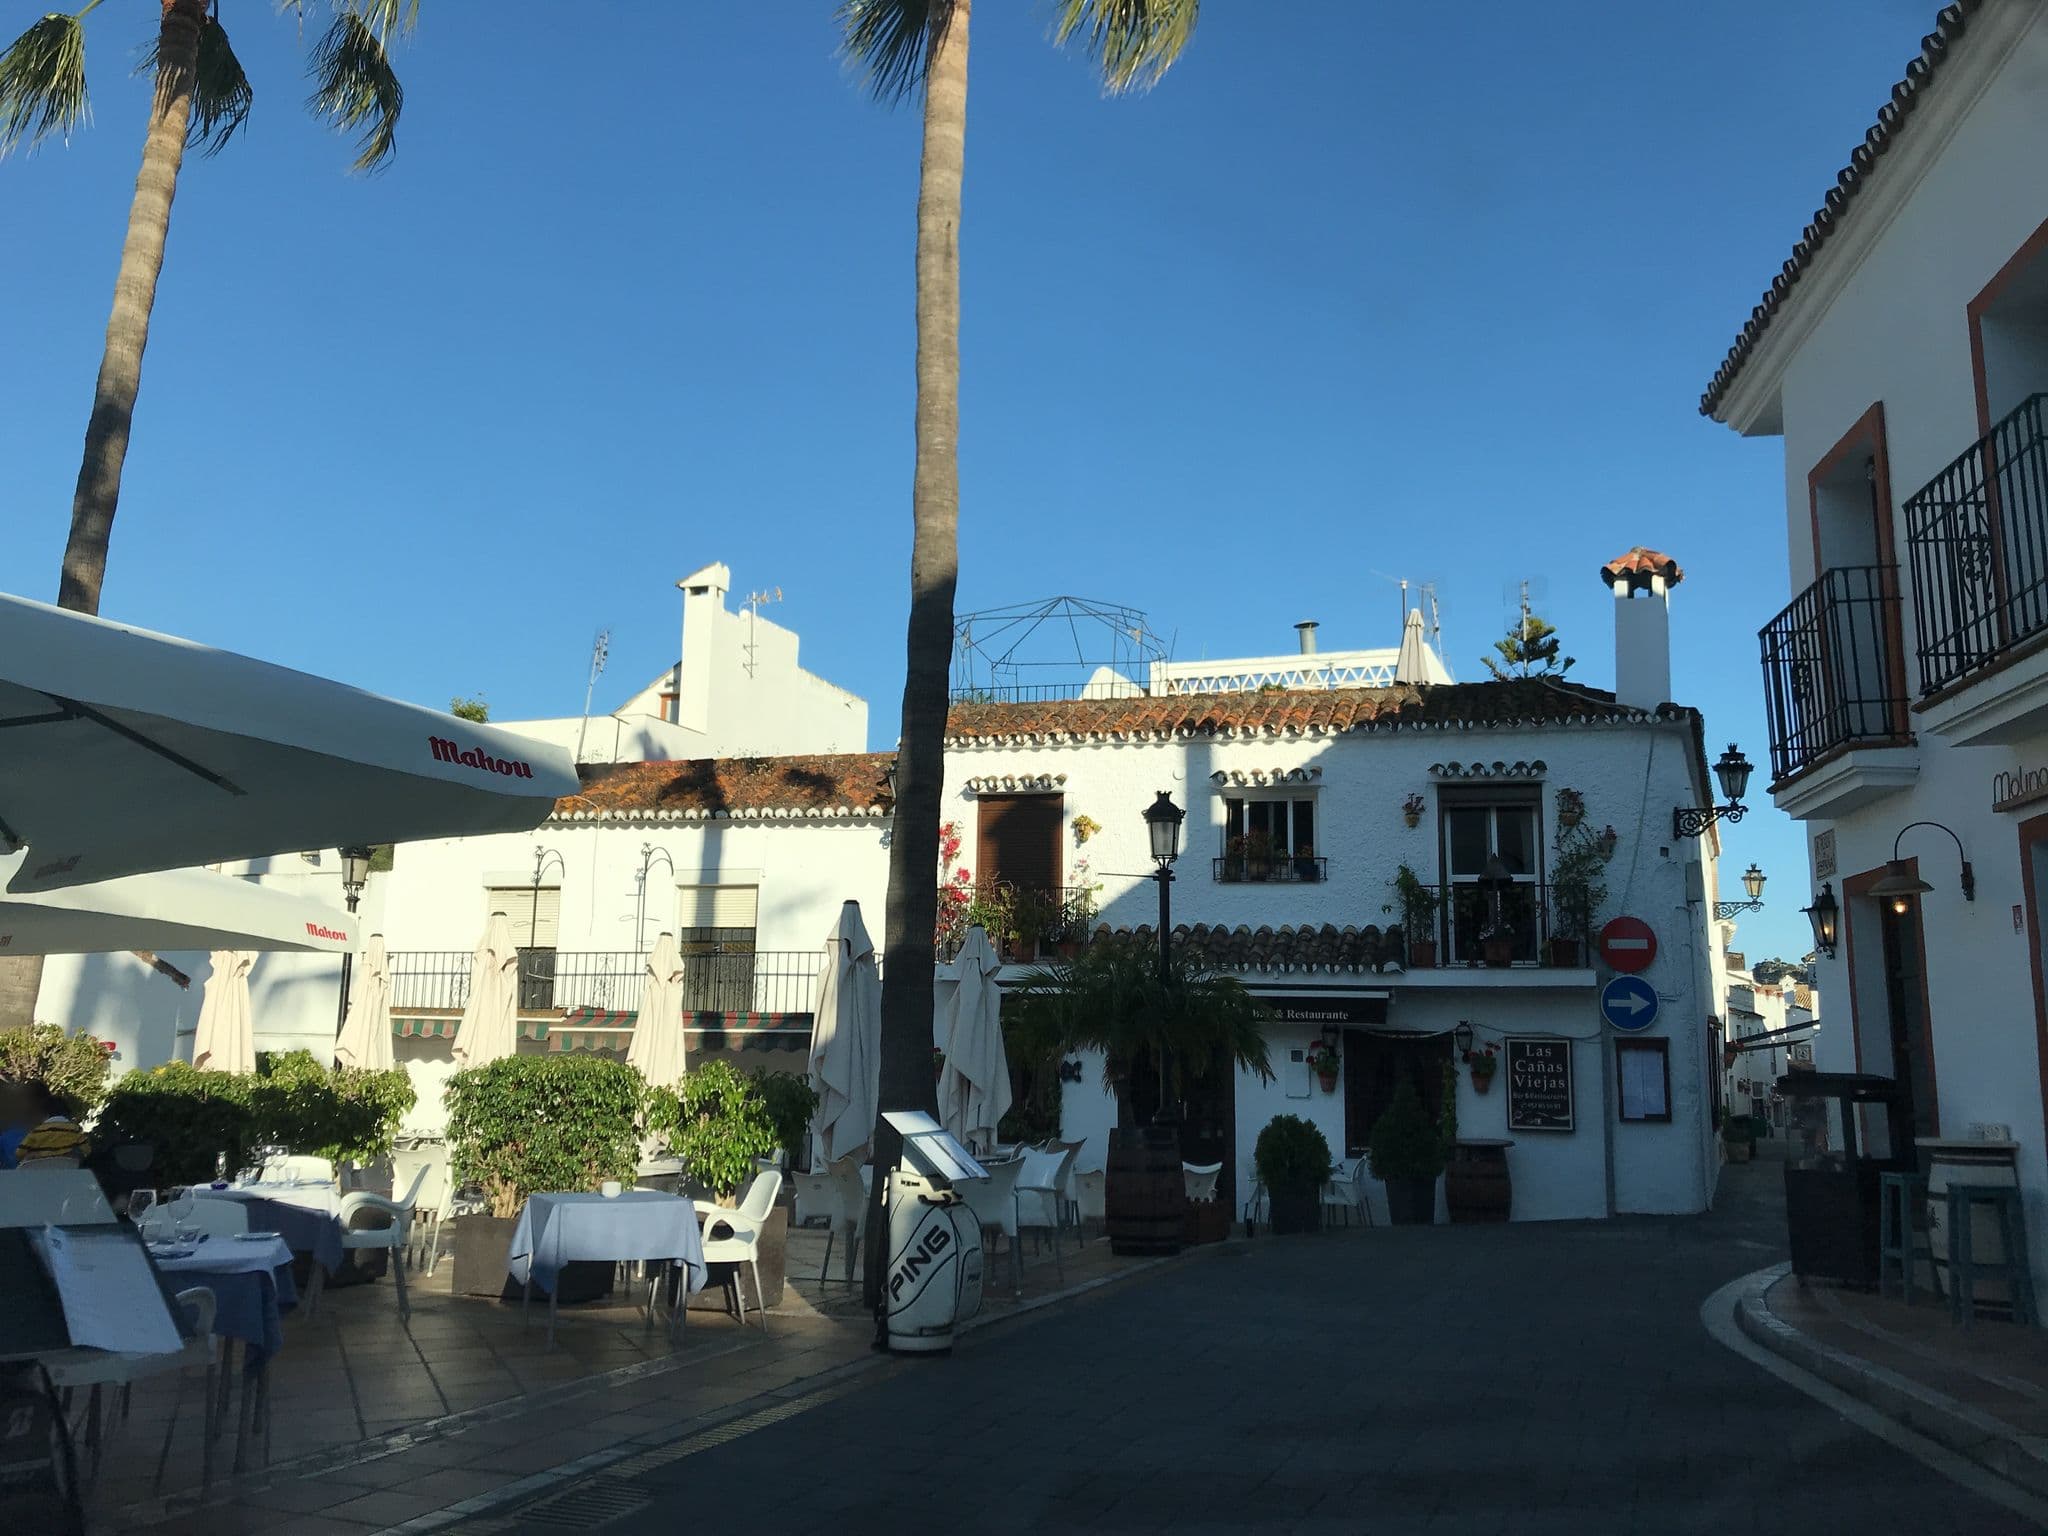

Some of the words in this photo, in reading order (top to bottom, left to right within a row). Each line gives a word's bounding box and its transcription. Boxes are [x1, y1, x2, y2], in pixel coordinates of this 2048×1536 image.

[428, 735, 535, 779] Mahou
[305, 921, 348, 942] Mahou
[1286, 1008, 1350, 1020] Restaurante
[1525, 1044, 1552, 1057] Las
[1515, 1059, 1564, 1073] Cañas
[1514, 1074, 1566, 1092] Viejas
[889, 1224, 951, 1303] PING
